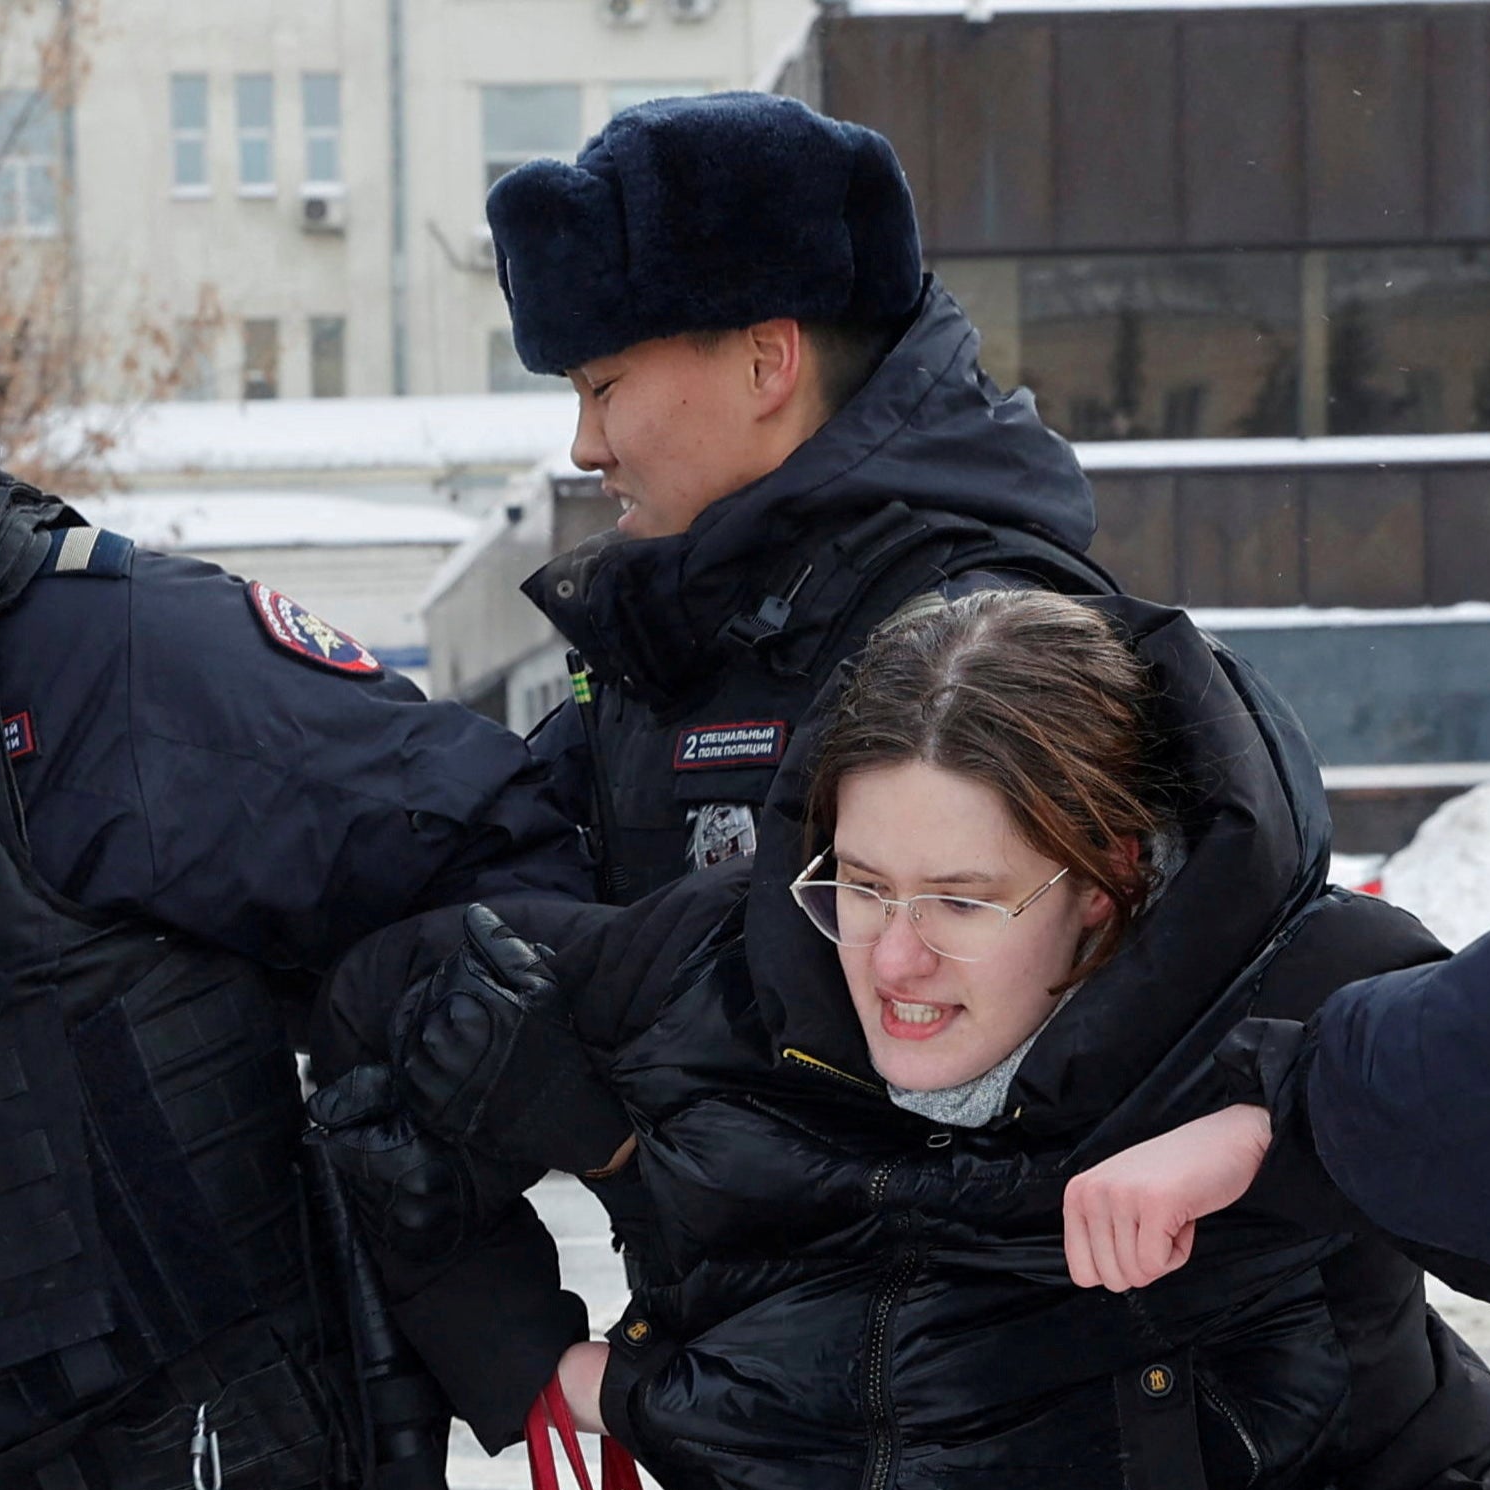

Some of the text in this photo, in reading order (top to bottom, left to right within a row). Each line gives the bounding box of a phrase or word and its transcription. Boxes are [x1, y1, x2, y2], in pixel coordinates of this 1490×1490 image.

[683, 726, 775, 759] 2 СПЕЦИАЛЬНЫЙ
[698, 743, 773, 759] ПОЛК ПОЛИЦИИ
